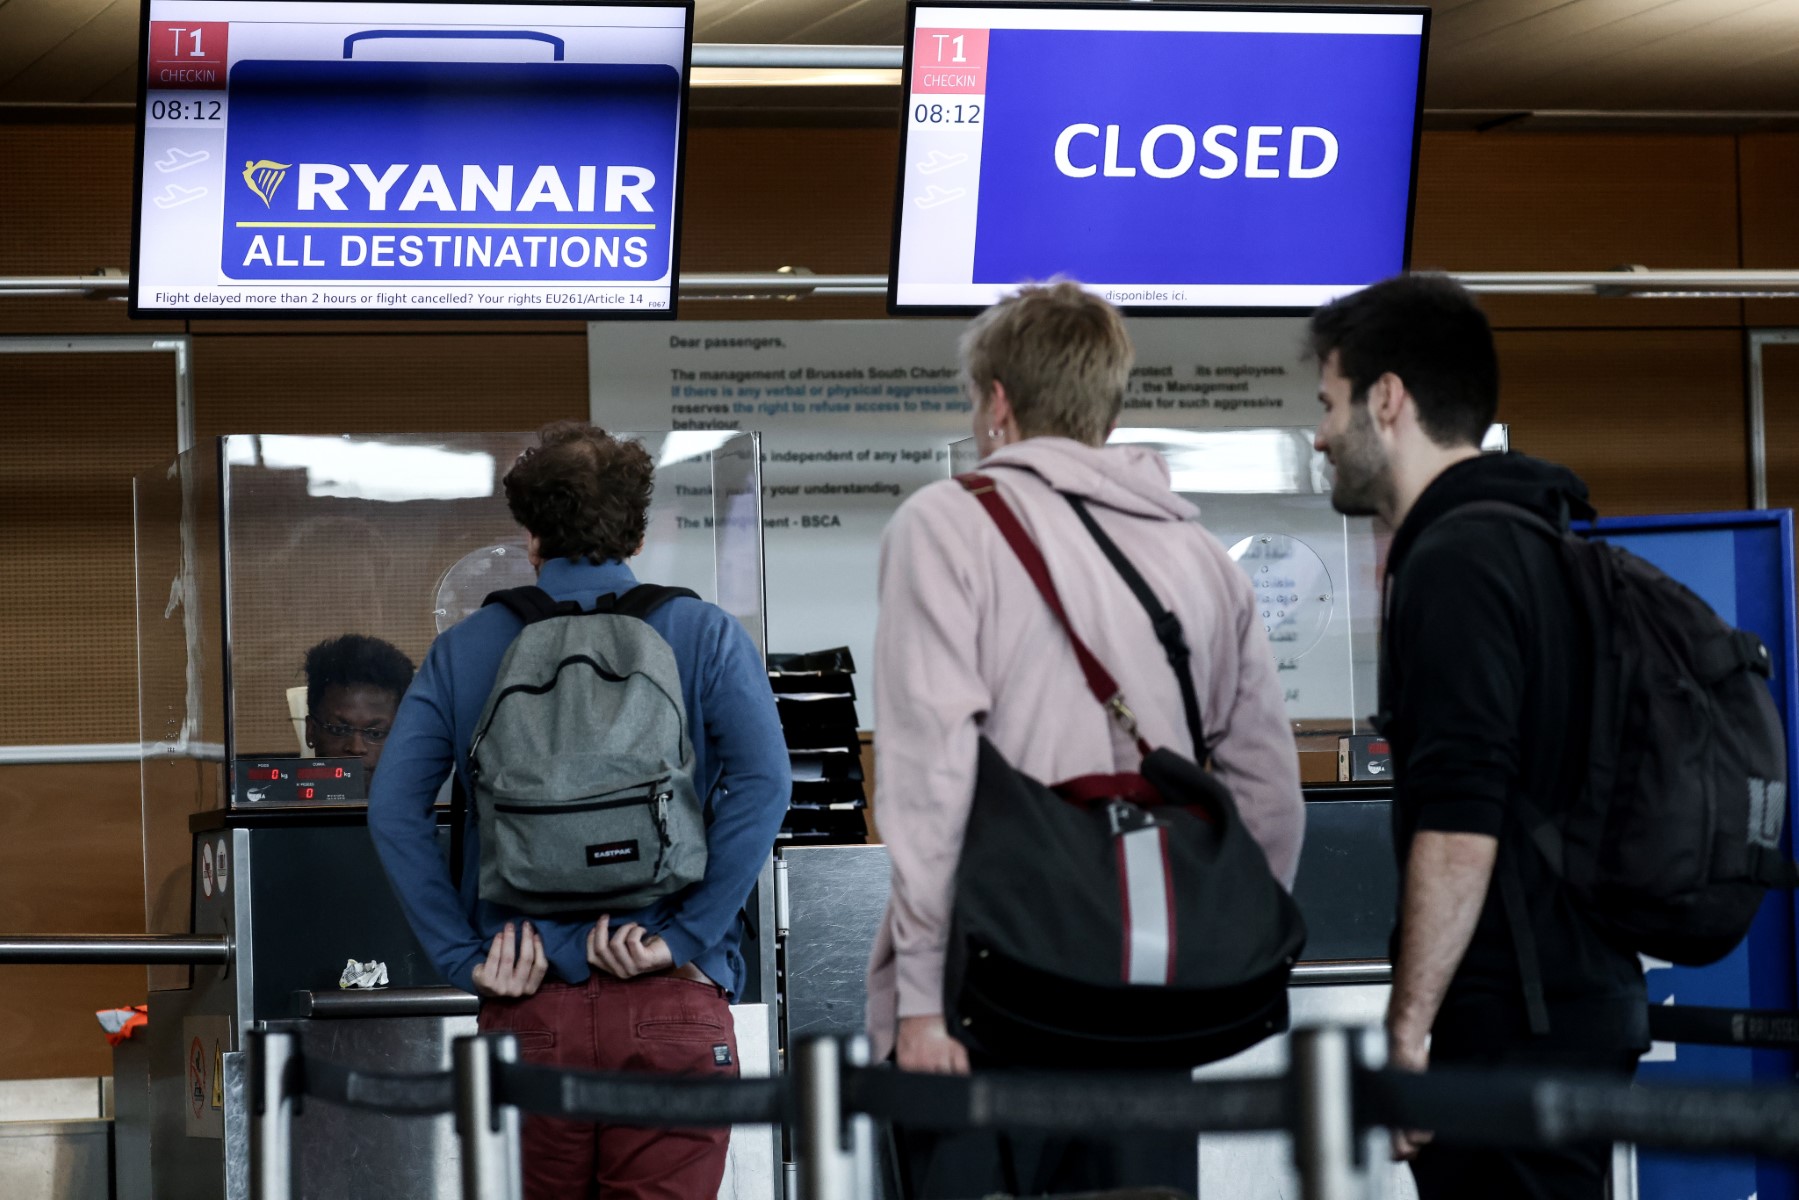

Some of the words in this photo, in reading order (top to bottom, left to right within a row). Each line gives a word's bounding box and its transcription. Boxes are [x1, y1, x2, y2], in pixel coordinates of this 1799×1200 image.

[168, 27, 206, 57] T1
[932, 34, 967, 63] T1
[160, 68, 215, 82] CHECKIN
[923, 74, 976, 88] CHECKIN
[151, 100, 222, 120] 08:12
[915, 104, 981, 124] 08:12
[1054, 123, 1339, 179] CLOSED
[297, 163, 656, 212] RYANAIR
[242, 234, 325, 267] ALL
[340, 235, 649, 268] DESTINATIONS
[155, 292, 190, 306] Flight
[193, 293, 242, 306] delayed
[245, 295, 277, 304] more
[281, 293, 308, 304] than
[311, 293, 319, 304] 2
[323, 293, 357, 304] hours
[360, 295, 374, 304] or
[376, 293, 407, 306] flight
[411, 293, 473, 305] cancelled?
[478, 294, 504, 305] Your
[508, 293, 542, 307] rights
[546, 293, 626, 305] EU261/Article
[629, 294, 644, 305] 14
[1105, 290, 1168, 302] disponibles
[1172, 290, 1188, 301] ici.
[670, 336, 699, 348] Dear
[671, 369, 695, 380] The
[699, 370, 785, 382] management
[788, 369, 802, 379] of
[806, 368, 864, 379] Brussels
[868, 367, 907, 378] South
[910, 366, 959, 378] Charler
[1197, 365, 1211, 377] its
[671, 385, 680, 397] If
[683, 386, 717, 397] there
[722, 386, 733, 397] is
[737, 387, 760, 399] any
[765, 385, 806, 397] verbal
[809, 387, 822, 396] or
[827, 384, 883, 398] physical
[886, 385, 959, 398] aggression
[1143, 382, 1163, 392] the
[1167, 380, 1249, 394] Management
[671, 404, 729, 414] reserves
[733, 402, 753, 413] the
[758, 402, 788, 415] right
[792, 402, 805, 413] to
[809, 401, 850, 412] refuse
[855, 402, 899, 411] access
[904, 400, 918, 411] to
[921, 400, 941, 411] the
[1156, 398, 1174, 408] for
[1179, 397, 1209, 408] such
[1213, 396, 1283, 410] aggressive
[771, 449, 853, 464] independent
[856, 449, 870, 461] of
[874, 451, 897, 464] any
[900, 449, 932, 464] legal
[770, 486, 800, 498] your
[676, 516, 699, 528] The
[801, 514, 841, 528] BSCA
[271, 769, 279, 780] 0
[280, 772, 288, 780] kg
[335, 767, 343, 778] 0
[306, 787, 314, 799] 0
[594, 848, 631, 858] EASTPAK
